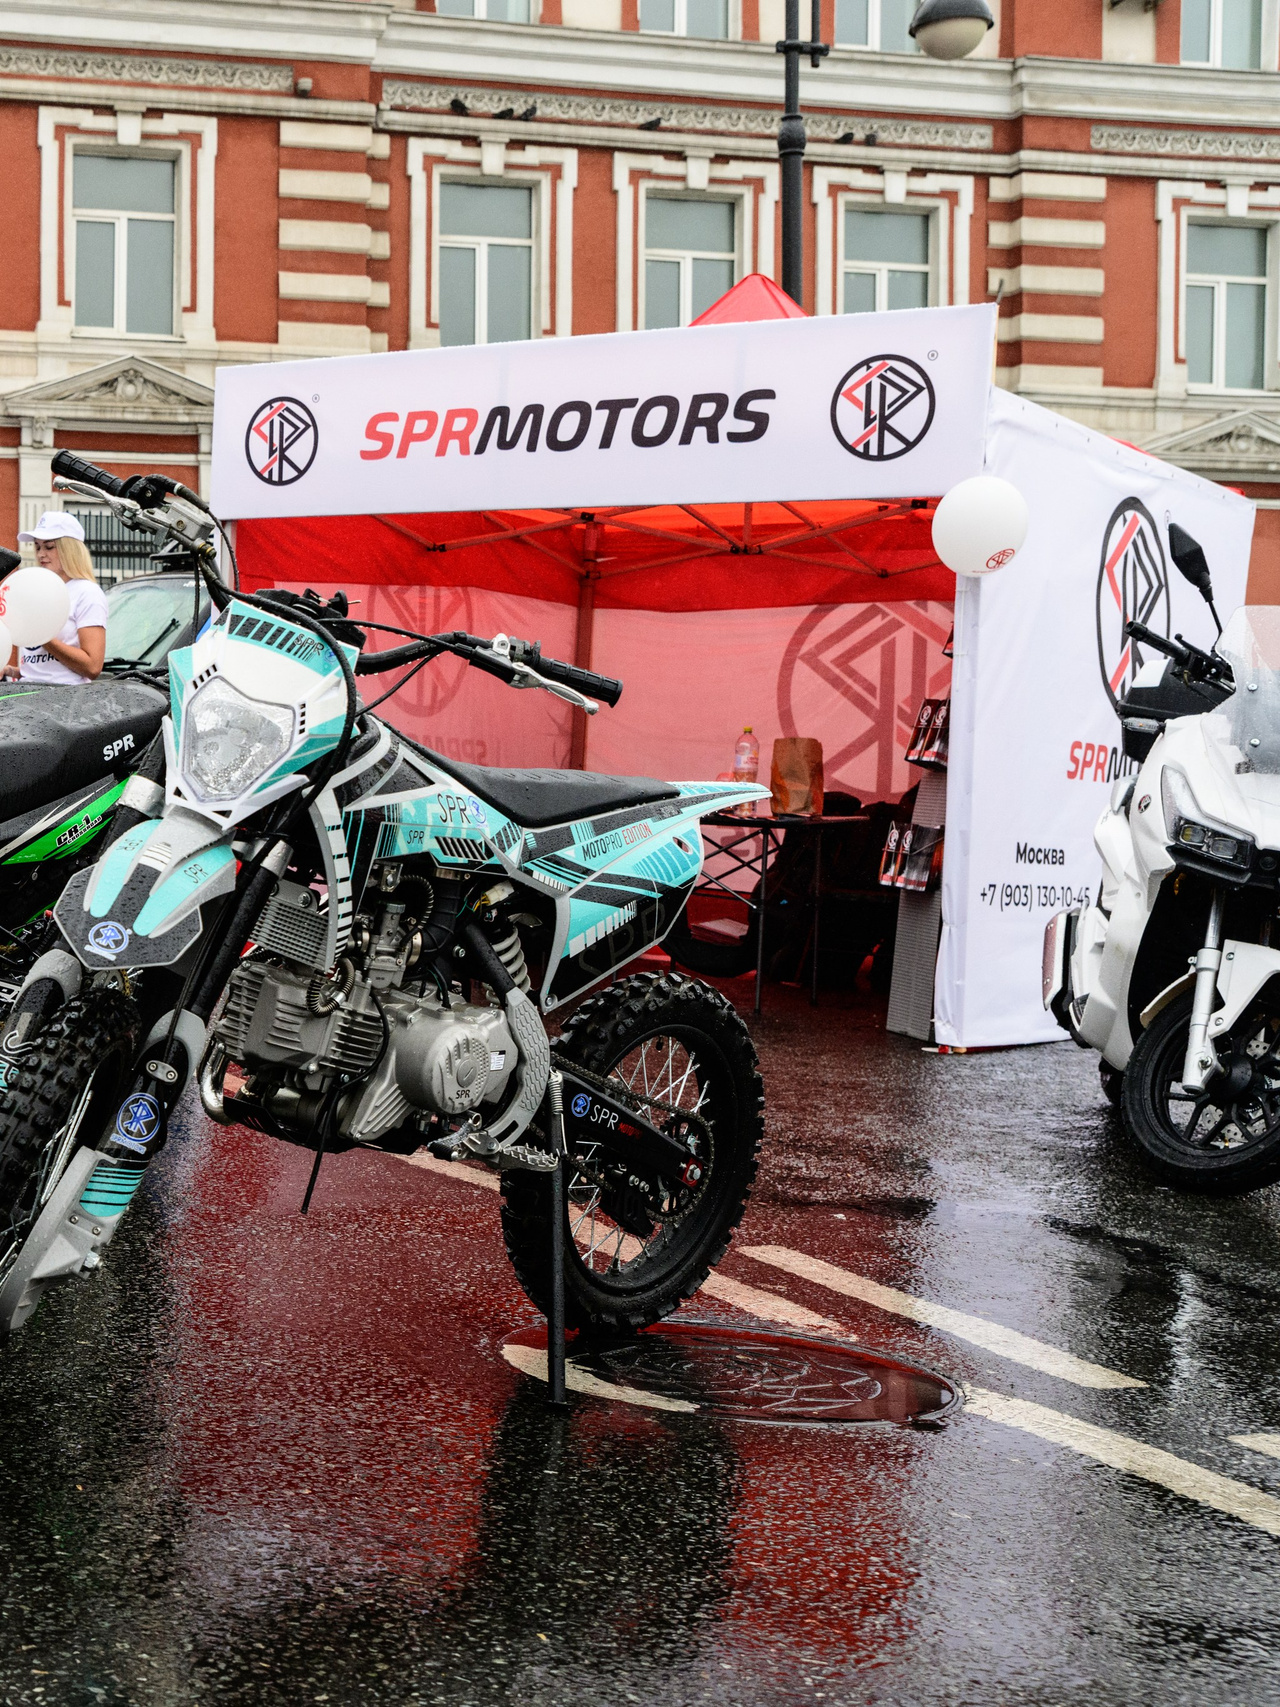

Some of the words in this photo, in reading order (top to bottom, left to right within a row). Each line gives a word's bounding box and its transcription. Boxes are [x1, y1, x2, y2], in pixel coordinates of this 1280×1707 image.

[360, 388, 776, 461] SPRMOTORS
[103, 734, 136, 762] SPR
[437, 793, 471, 824] SPR
[56, 813, 93, 847] CR-1
[407, 829, 424, 844] SPR
[582, 832, 623, 861] MOTOPRO
[621, 823, 653, 845] EDITION
[1015, 842, 1065, 866] Москва
[184, 863, 209, 884] SPR
[980, 884, 997, 907] +7
[1000, 883, 1033, 912] (903)
[1037, 885, 1090, 908] 130-10-45
[455, 1089, 471, 1099] SPR
[590, 1105, 619, 1130] SPR
